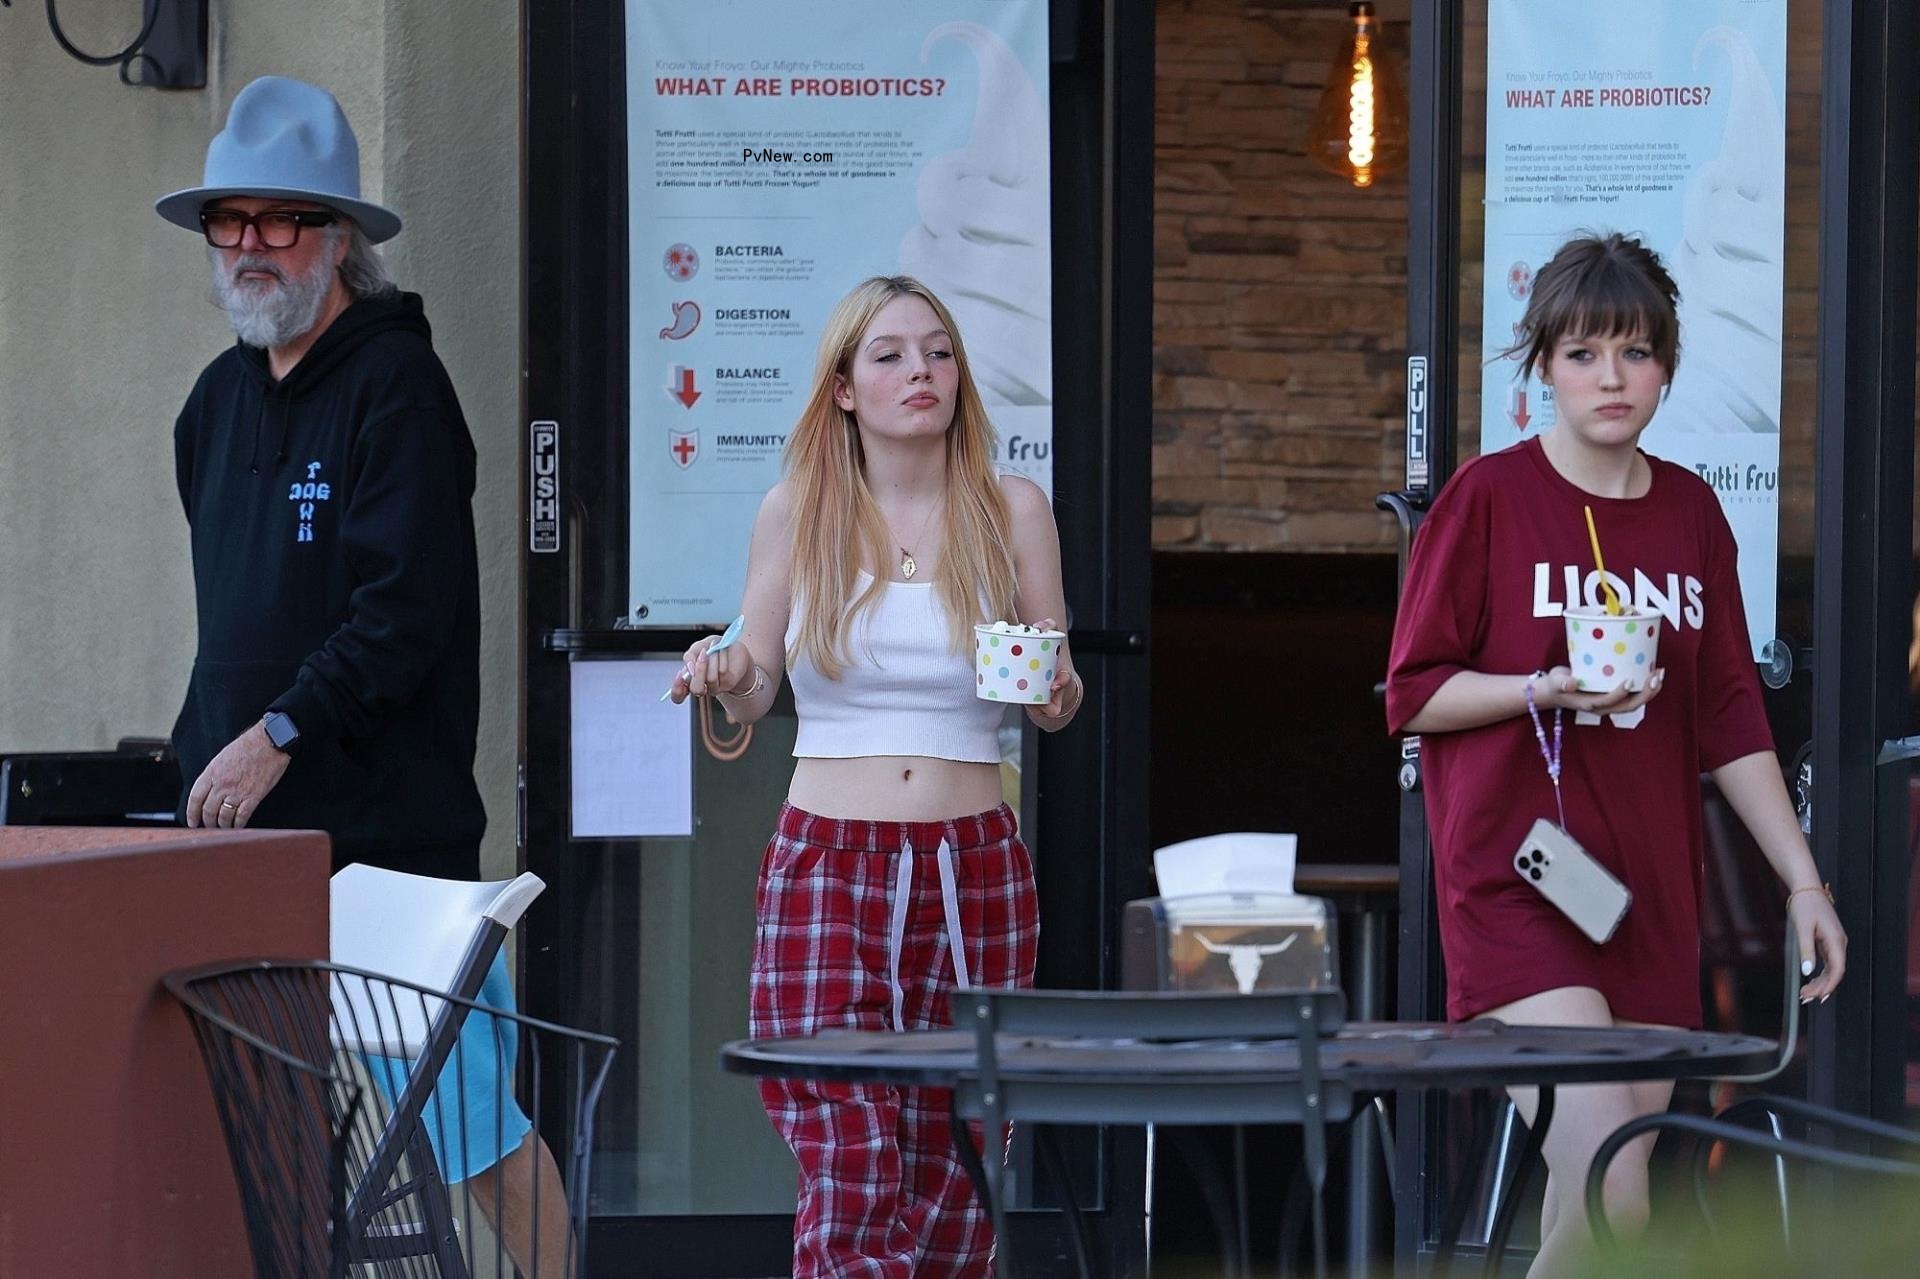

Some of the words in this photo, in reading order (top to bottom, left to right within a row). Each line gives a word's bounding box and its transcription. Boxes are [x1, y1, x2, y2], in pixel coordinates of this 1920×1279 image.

[655, 60, 685, 70] Know
[688, 60, 710, 70] Your
[750, 60, 770, 70] Our
[773, 60, 810, 72] Mighty
[813, 60, 864, 70] Probiotics
[1573, 71, 1587, 80] Our
[1589, 71, 1614, 82] Mighty
[1617, 70, 1653, 79] Probiotics
[655, 78, 726, 96] WHAT
[734, 78, 782, 96] ARE
[790, 78, 946, 96] PROBIOTICS?
[1506, 90, 1555, 108] WHAT
[1560, 89, 1594, 107] ARE
[1600, 86, 1711, 107] PROBIOTICS?
[715, 246, 783, 256] BACTERIA
[715, 309, 791, 320] DIGESTION
[716, 368, 781, 379] BALANCE
[1411, 368, 1424, 459] PULL
[716, 435, 787, 446] IMMUNITY
[535, 432, 555, 521] PUSH
[1695, 463, 1739, 491] Tutti
[1533, 562, 1705, 632] LIONS
